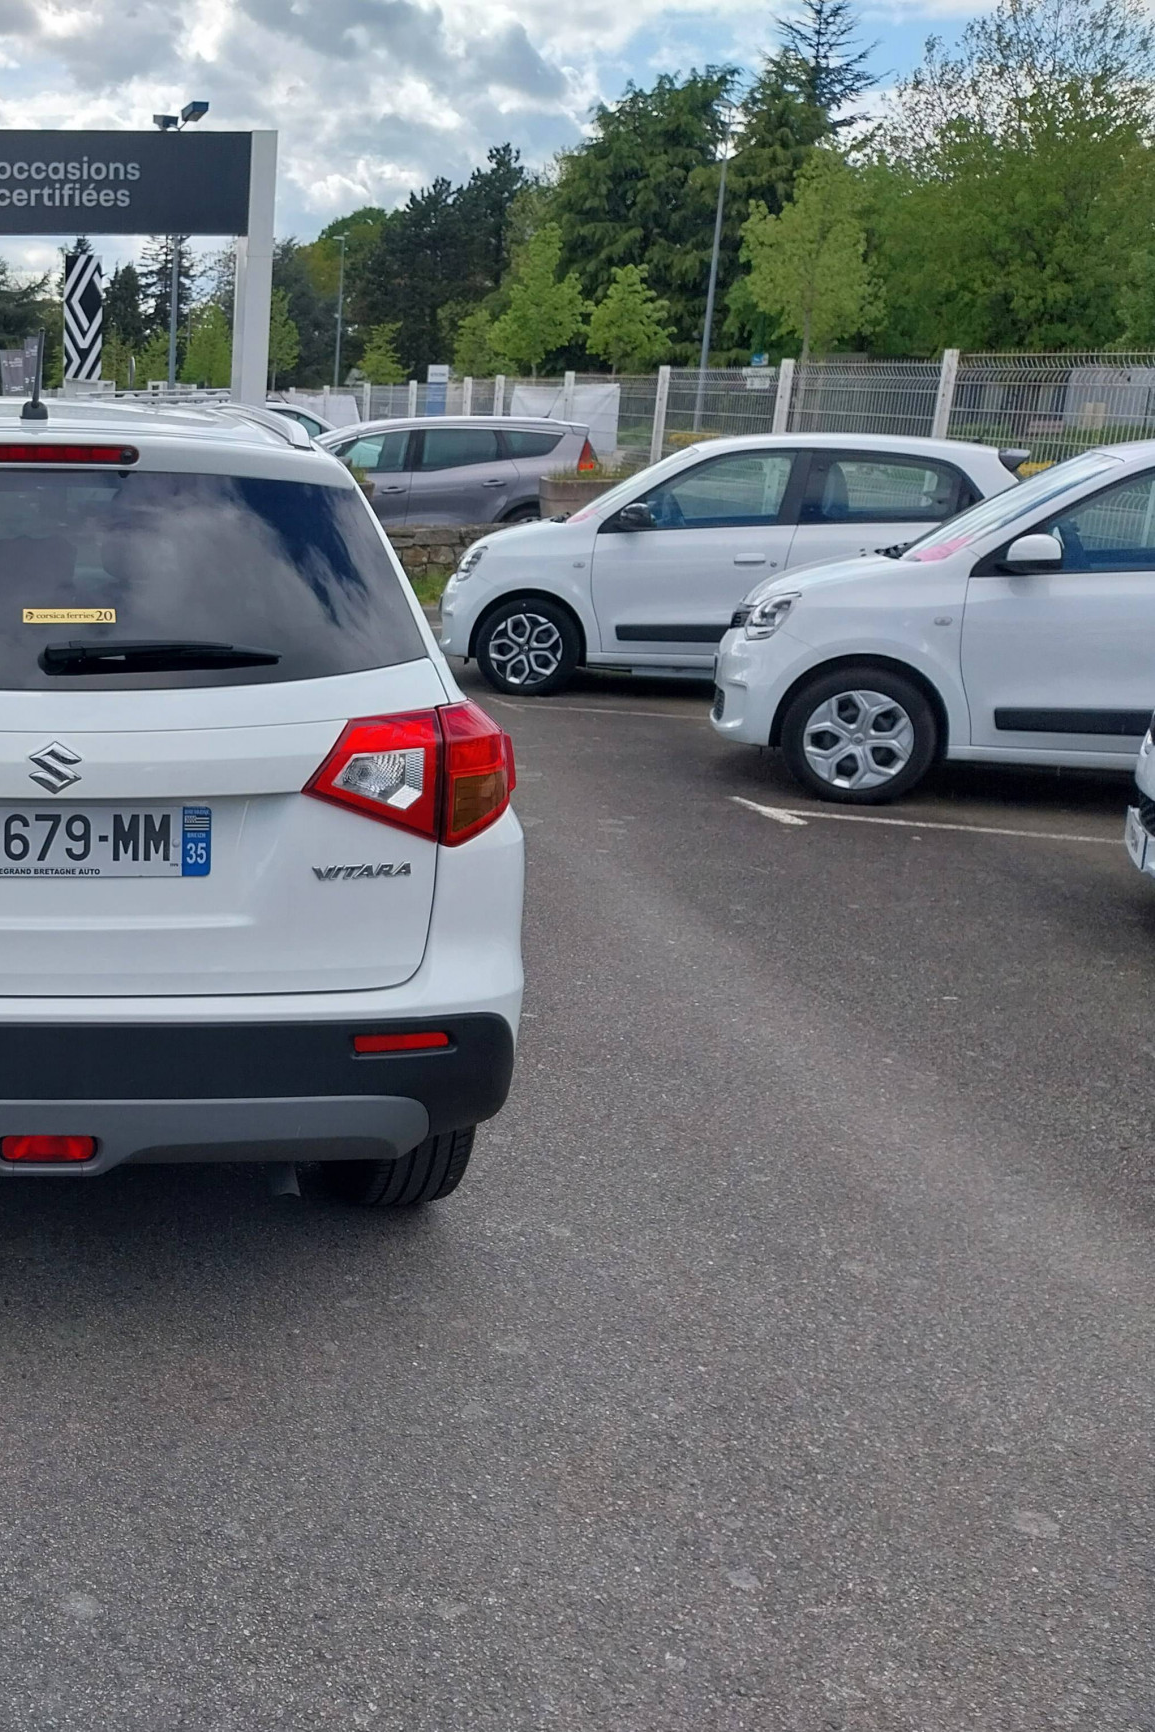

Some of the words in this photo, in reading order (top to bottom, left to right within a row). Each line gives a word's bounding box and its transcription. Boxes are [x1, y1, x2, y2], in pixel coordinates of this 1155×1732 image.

[36, 611, 66, 619] corsica
[67, 611, 95, 619] ferries
[95, 610, 113, 621] 20
[186, 842, 207, 864] 35
[312, 861, 412, 881] VITARA
